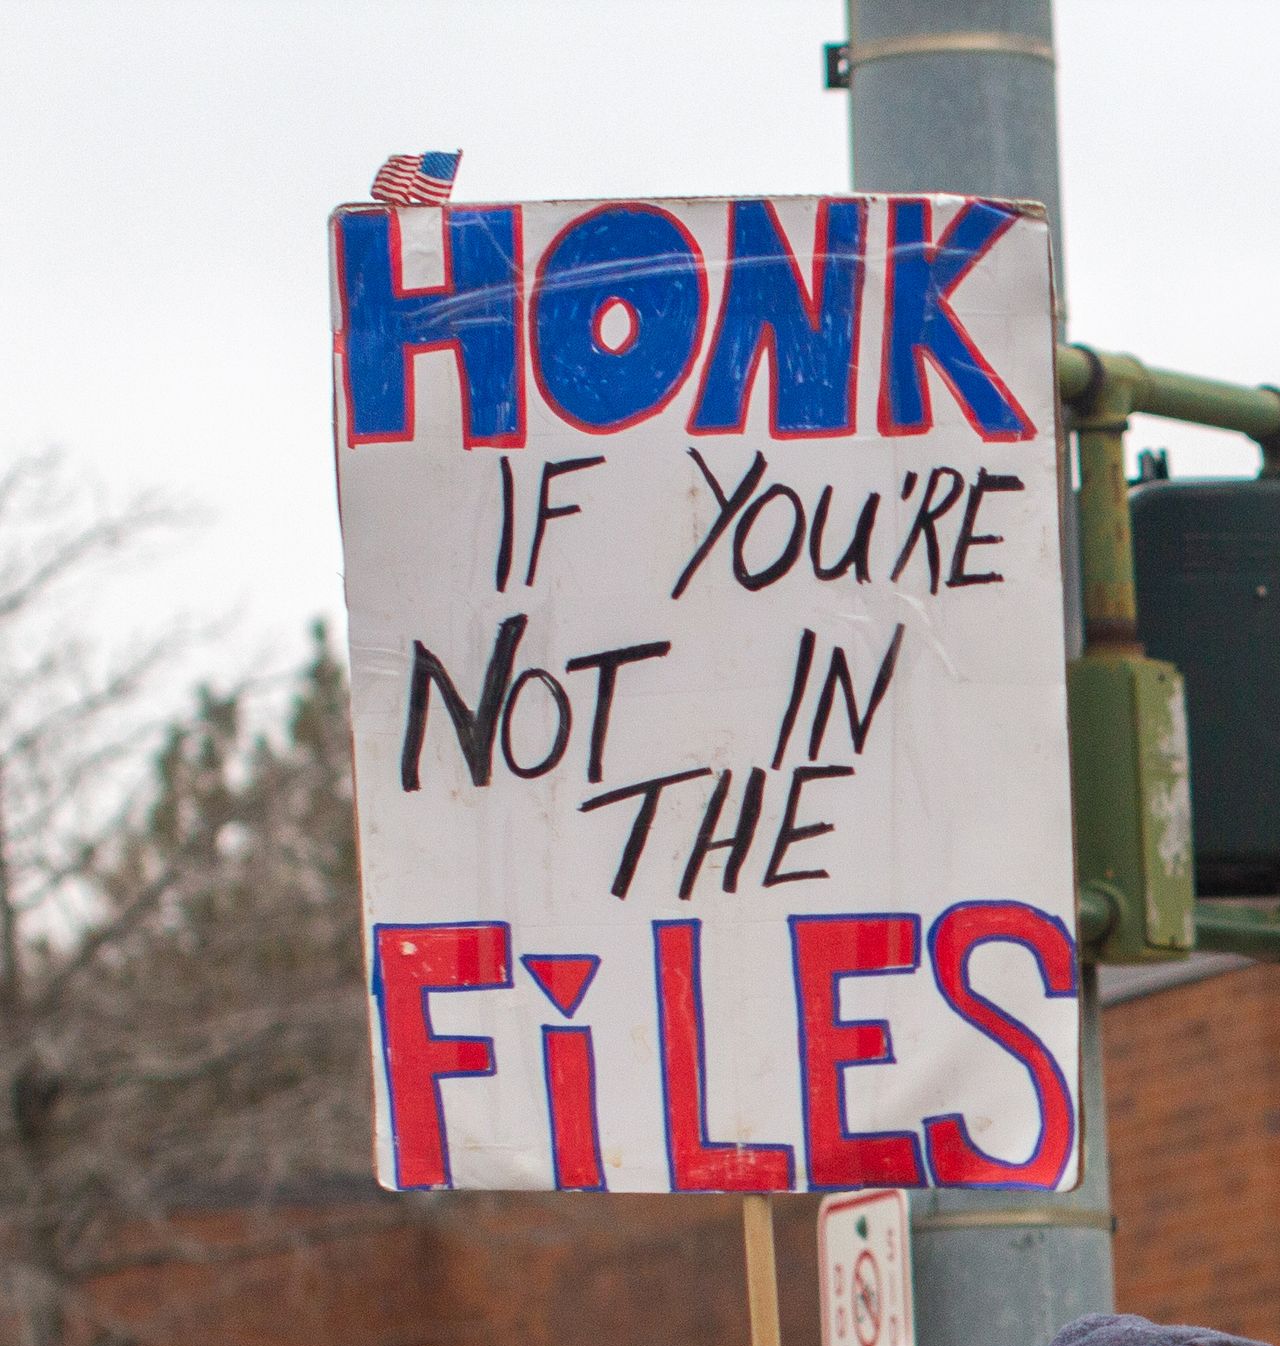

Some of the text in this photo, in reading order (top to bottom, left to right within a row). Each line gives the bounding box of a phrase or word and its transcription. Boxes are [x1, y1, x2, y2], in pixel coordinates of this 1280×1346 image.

[332, 195, 1040, 450] HONK
[495, 445, 1026, 602] IF YOU'RE
[402, 614, 906, 792] NOT IN
[577, 764, 855, 900] THE
